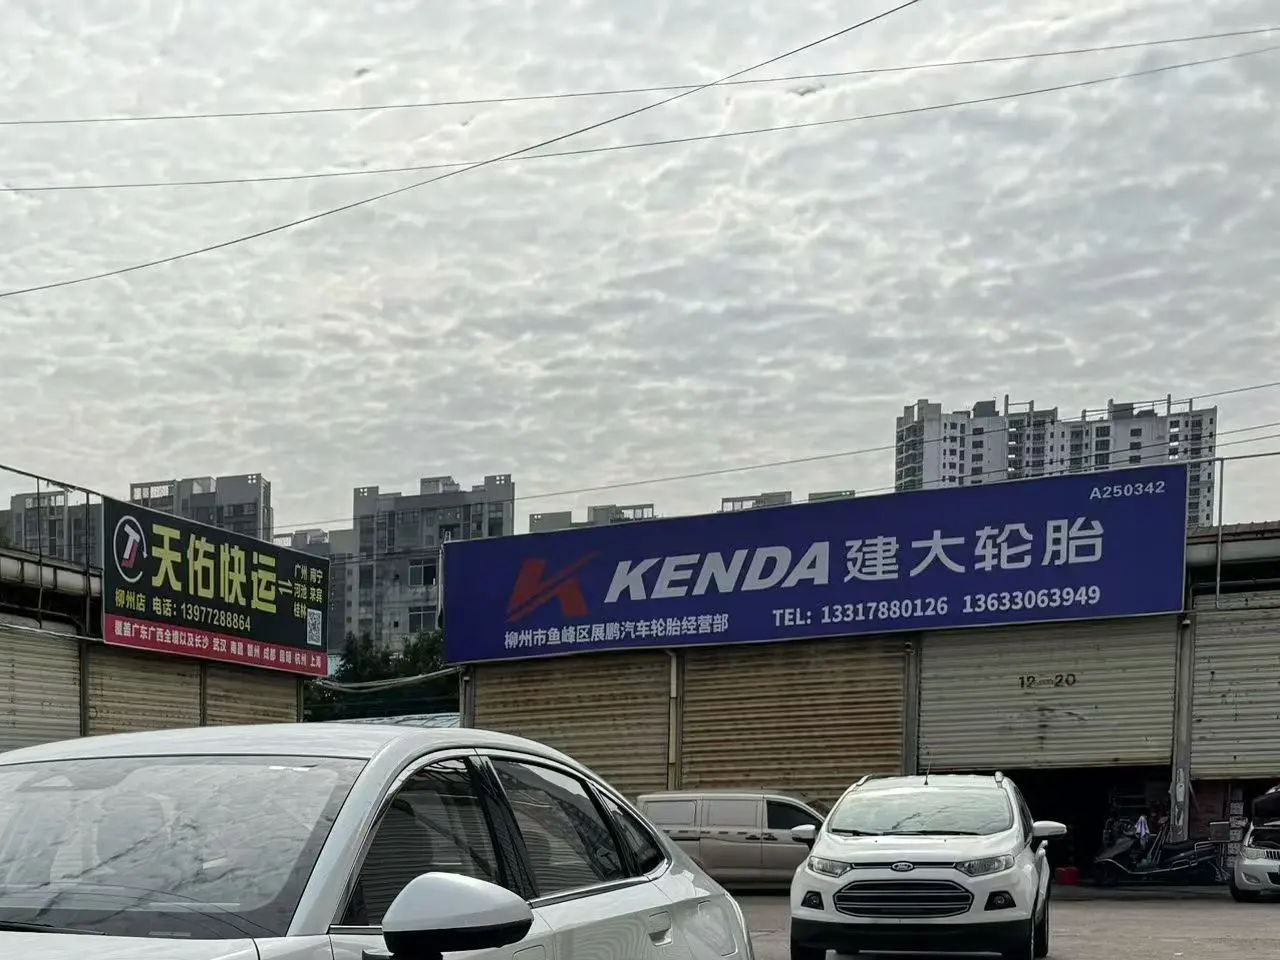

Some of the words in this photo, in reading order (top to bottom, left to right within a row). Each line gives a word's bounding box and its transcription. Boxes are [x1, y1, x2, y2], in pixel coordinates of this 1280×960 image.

[1089, 480, 1166, 500] A250342
[151, 523, 277, 614] 天佑快运
[603, 541, 830, 603] KENDA
[844, 516, 1104, 583] 建大轮胎
[115, 588, 146, 612] 柳州店
[180, 602, 251, 632] 13977288864
[293, 601, 307, 619] 桂林
[504, 613, 729, 649] 柳州市鱼峰区展鹏汽车轮胎经营部
[773, 608, 813, 627] TEL:
[821, 597, 948, 624] 13317880126
[962, 585, 1101, 614] 13633063949
